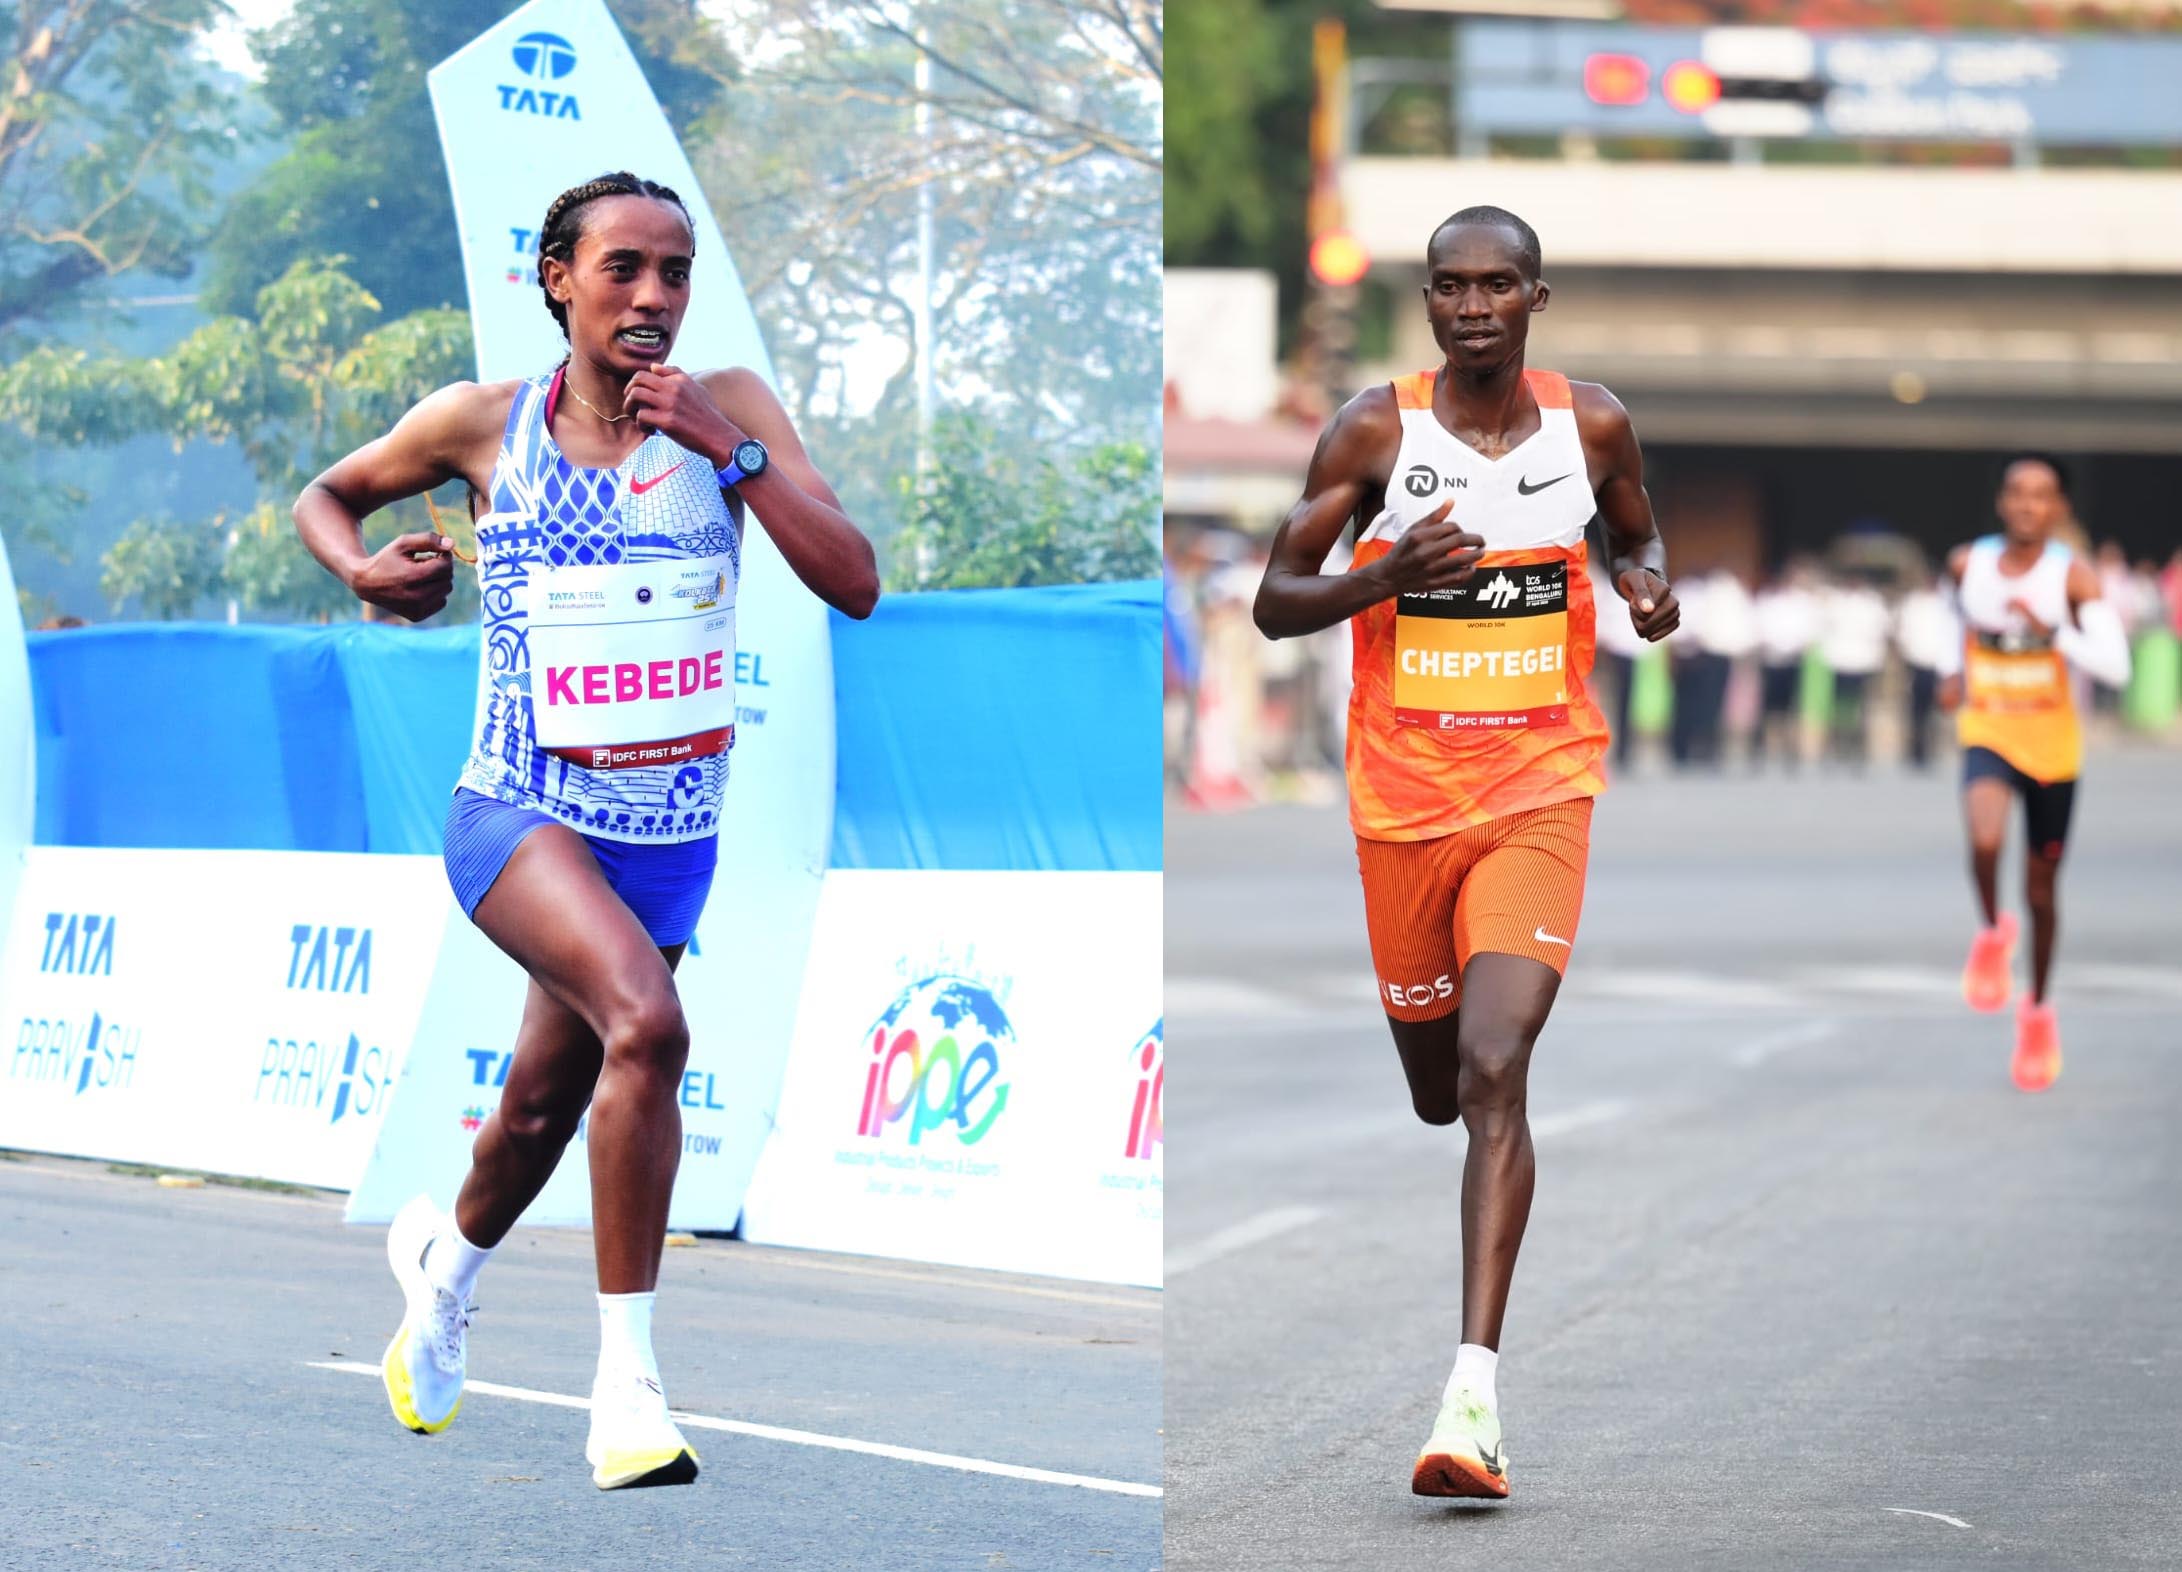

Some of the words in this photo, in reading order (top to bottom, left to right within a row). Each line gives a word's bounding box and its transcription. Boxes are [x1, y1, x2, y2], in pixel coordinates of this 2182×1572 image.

[496, 84, 582, 121] TATA
[1444, 477, 1468, 488] NN
[548, 592, 576, 600] TATA
[578, 591, 605, 600] STEEL
[1526, 584, 1551, 593] WORLD
[1526, 590, 1563, 601] BENGALURU
[1400, 644, 1563, 678] CHEPTEGEI
[546, 650, 724, 706] KEBEDE
[1455, 717, 1478, 726] IDFC
[1479, 716, 1506, 726] FIRST
[1507, 715, 1528, 725] Bank
[613, 751, 637, 763] IDFC
[639, 748, 669, 760] FIRST
[671, 743, 693, 756] Bank
[41, 912, 116, 976] TATA
[287, 924, 373, 995] TATA
